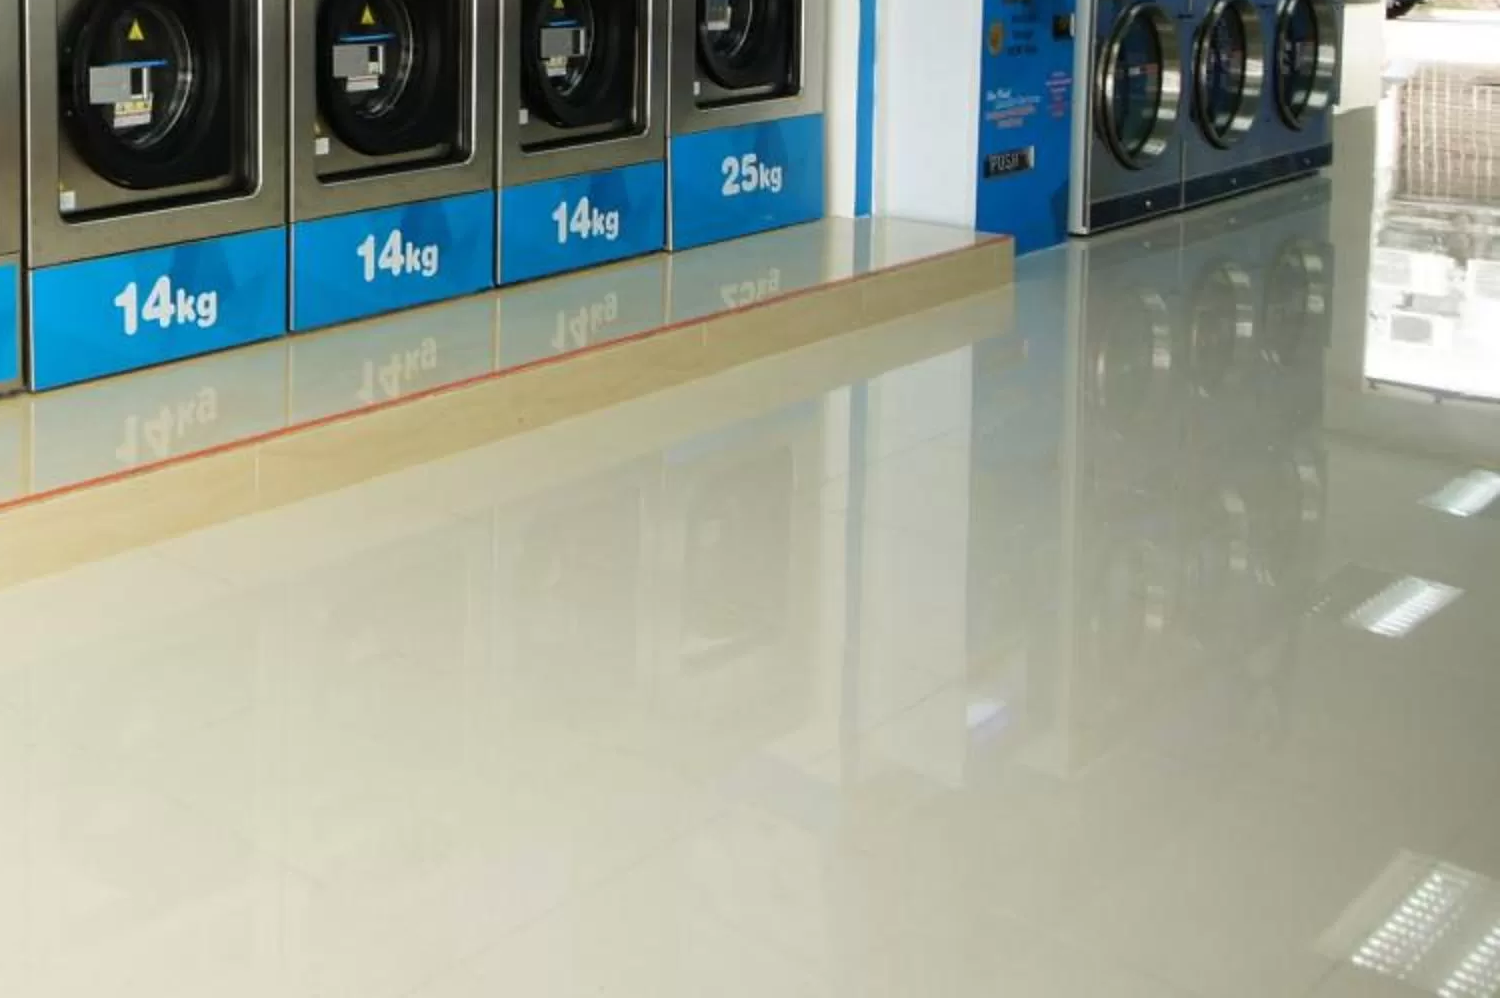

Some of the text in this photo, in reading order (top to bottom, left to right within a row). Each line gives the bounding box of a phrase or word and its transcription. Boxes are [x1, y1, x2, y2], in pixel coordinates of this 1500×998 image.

[721, 153, 782, 194] 25kg
[552, 196, 619, 244] 14kg
[356, 229, 438, 281] 14kg
[114, 274, 217, 335] 14kg
